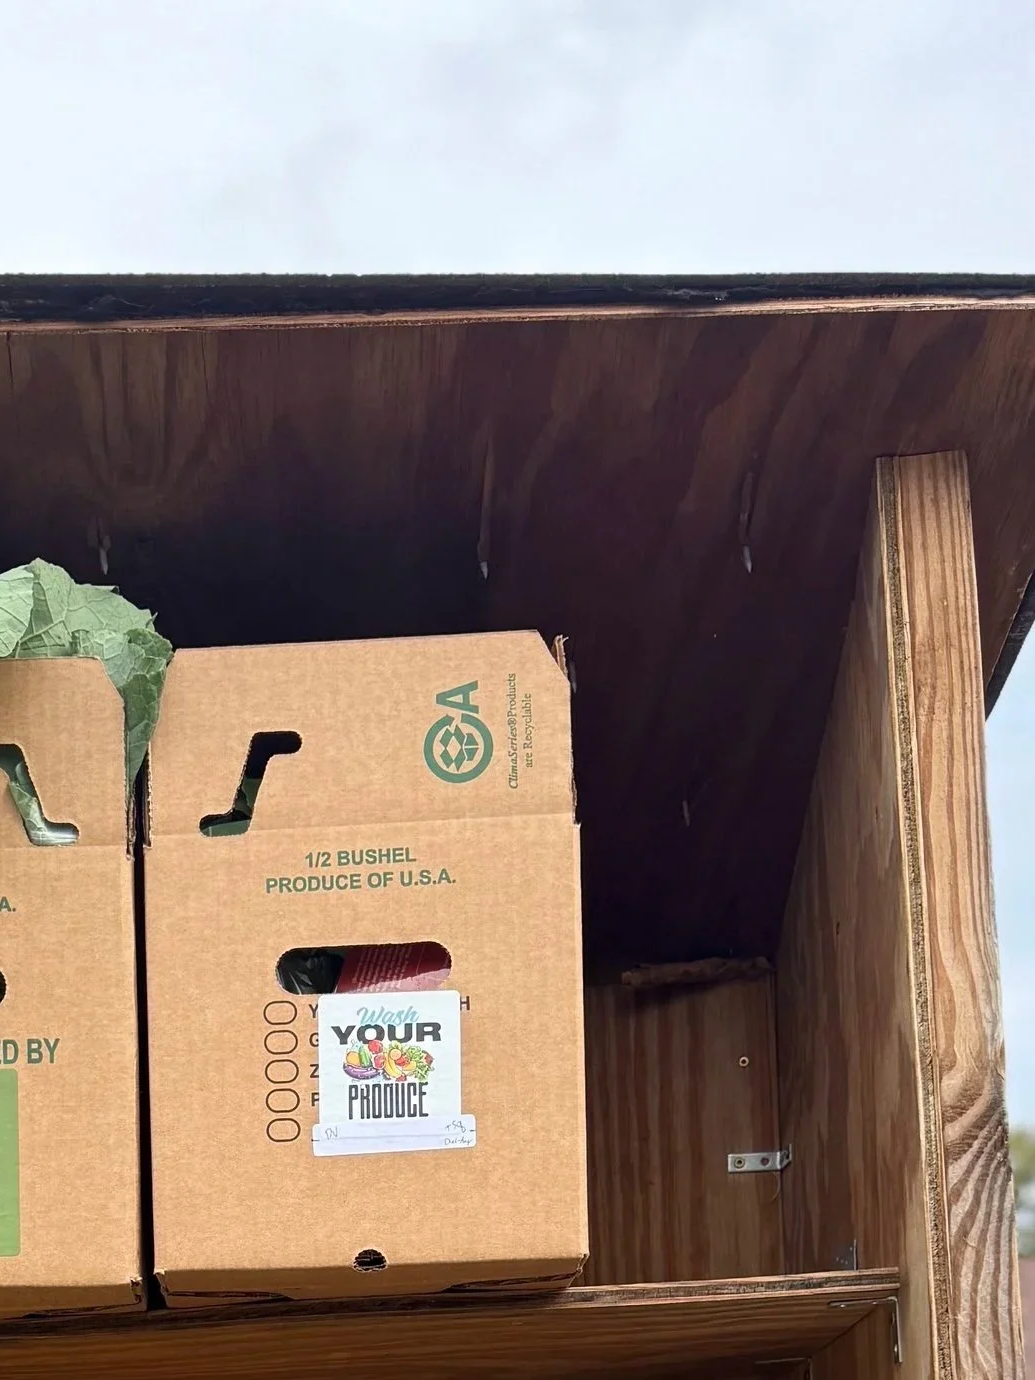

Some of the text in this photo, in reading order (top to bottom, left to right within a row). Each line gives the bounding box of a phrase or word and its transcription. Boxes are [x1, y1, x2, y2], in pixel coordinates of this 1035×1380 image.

[521, 693, 535, 768] are Recyclable
[305, 847, 416, 869] 1/2 BUSHEL
[265, 868, 456, 894] PRODUCE OF U.S.A.
[357, 1006, 419, 1027] Wash
[331, 1022, 442, 1045] YOUR
[26, 1037, 60, 1065] BY
[348, 1081, 429, 1120] PRODUCE
